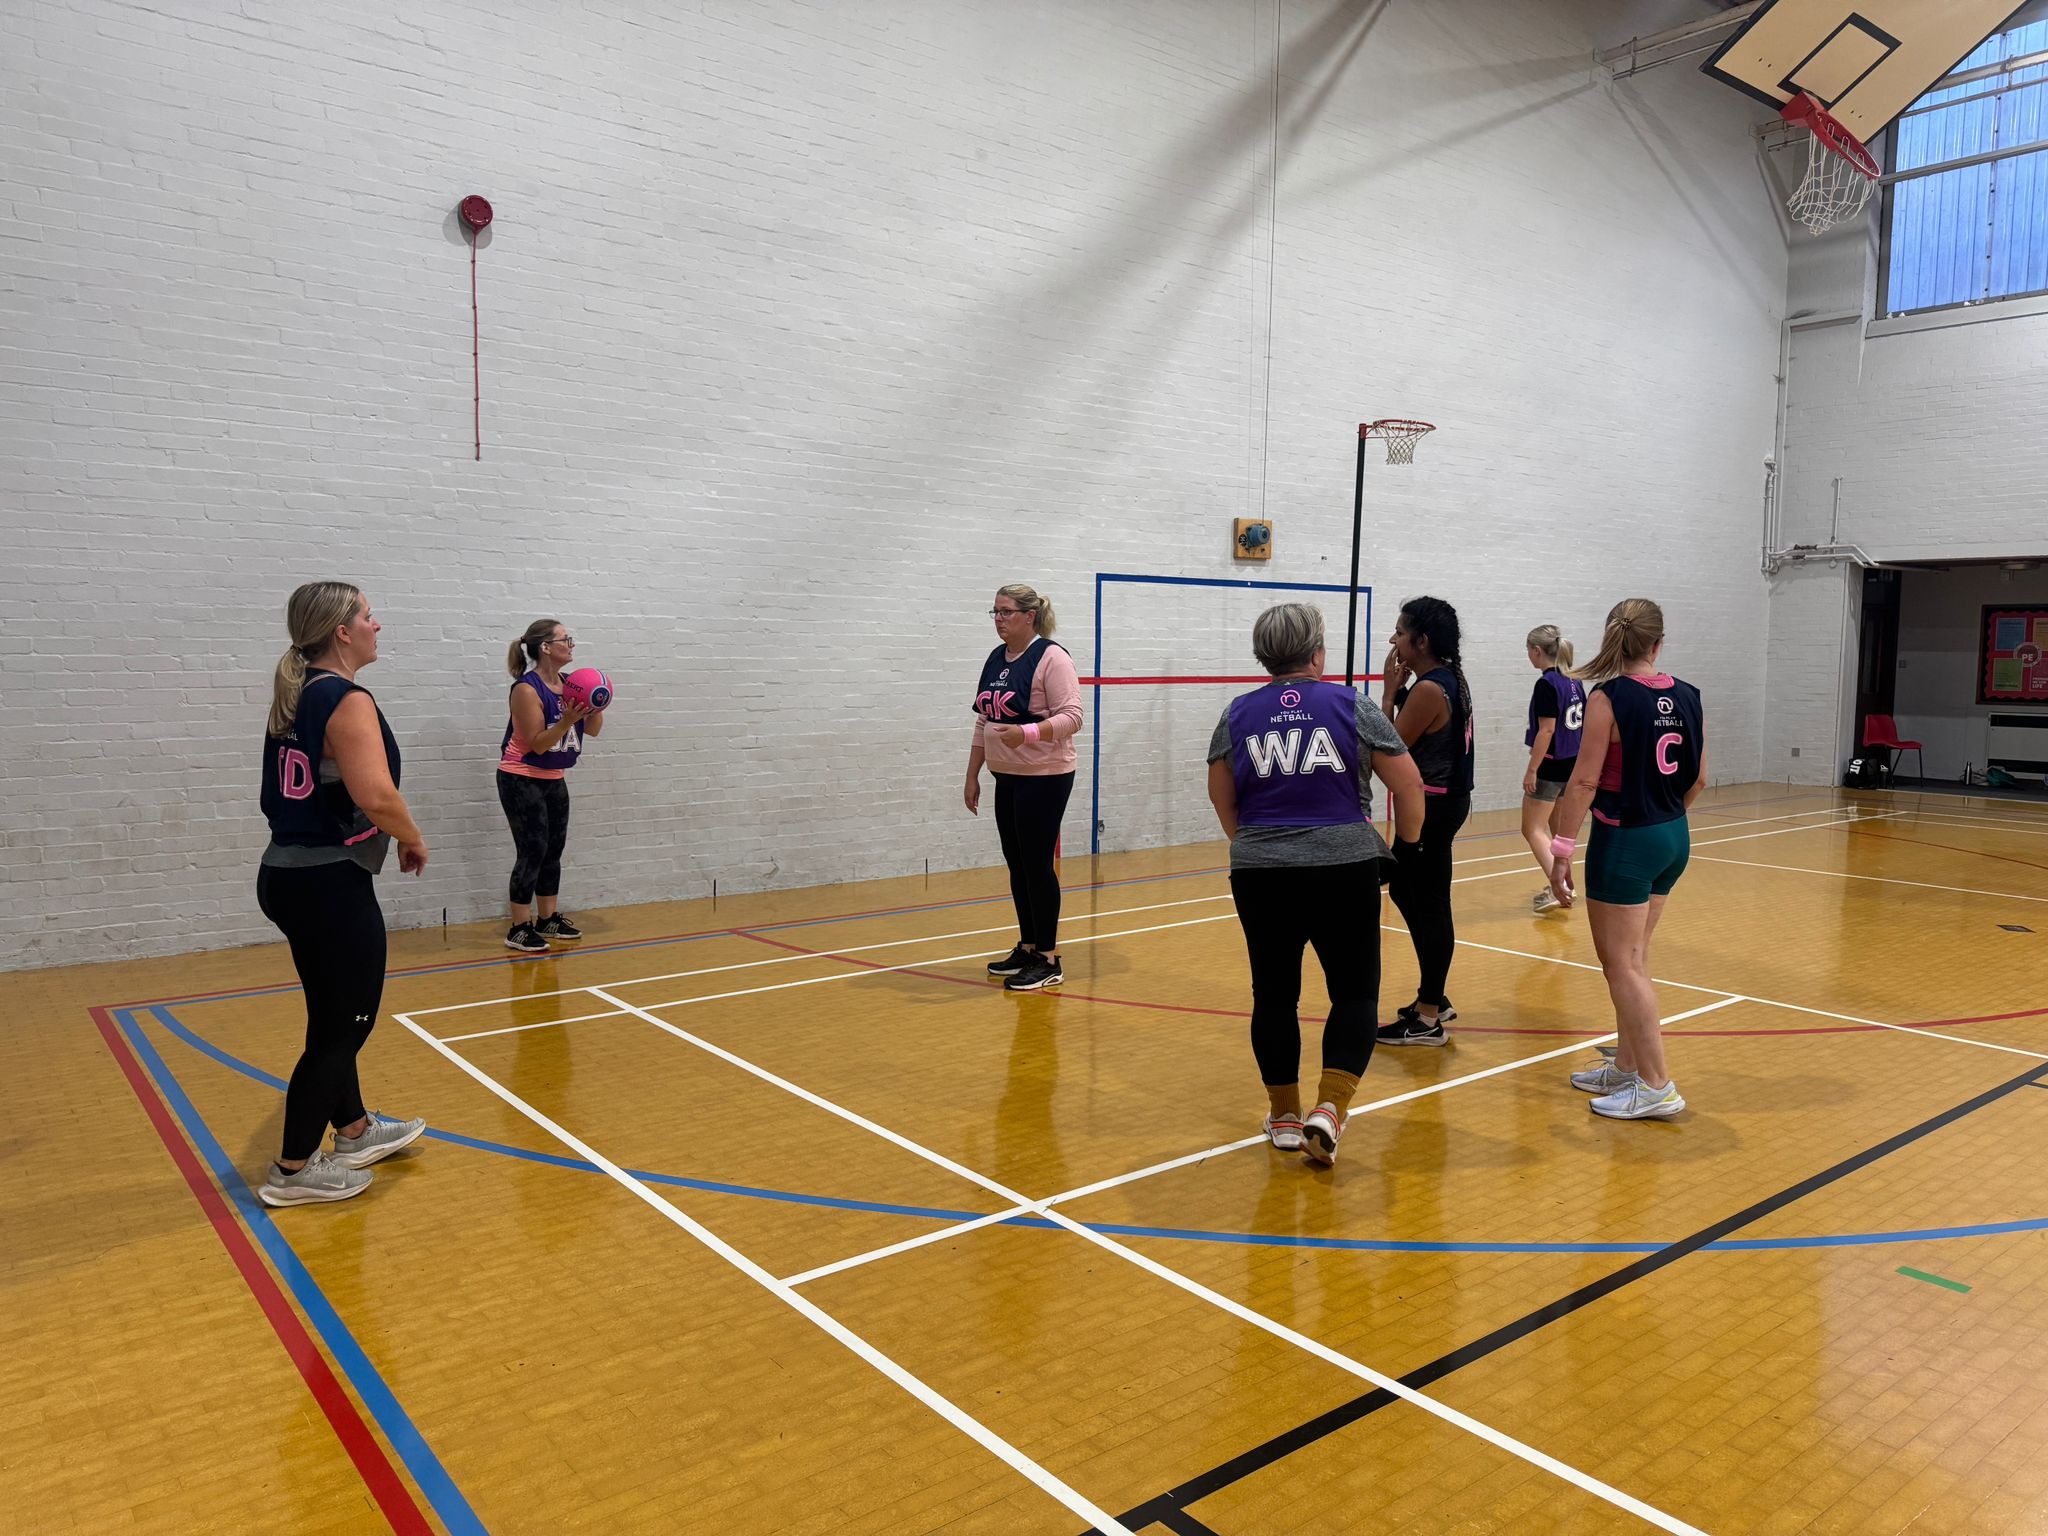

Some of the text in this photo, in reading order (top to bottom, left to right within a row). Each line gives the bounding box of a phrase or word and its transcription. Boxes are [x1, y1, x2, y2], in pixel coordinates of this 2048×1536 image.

[2022, 653, 2033, 661] PE
[976, 690, 1020, 720] GK
[1270, 713, 1314, 724] NETBALL
[1654, 719, 1683, 727] NETBALL
[1246, 727, 1346, 778] WA
[1656, 732, 1683, 775] C
